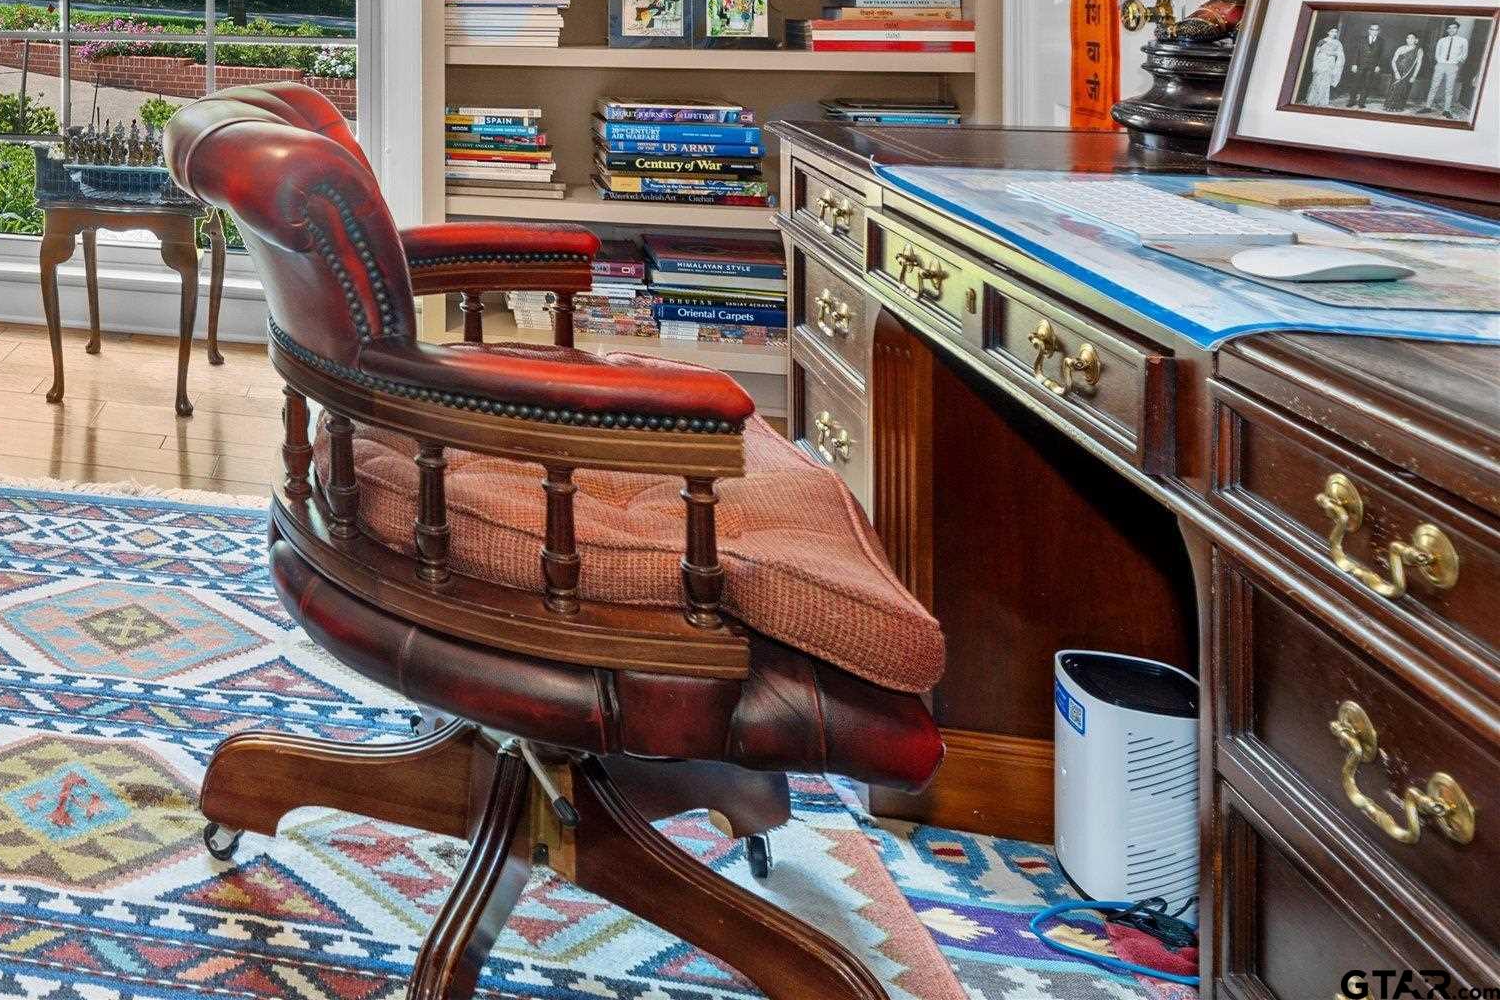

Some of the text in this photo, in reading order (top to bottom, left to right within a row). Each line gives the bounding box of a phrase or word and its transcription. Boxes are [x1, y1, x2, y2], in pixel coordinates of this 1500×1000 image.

[638, 111, 673, 119] JOURNEYS
[684, 112, 717, 120] LIFETIME
[486, 117, 512, 125] SPAIN
[663, 143, 716, 153] US ARMY
[635, 157, 683, 172] Century
[684, 160, 696, 171] of
[696, 160, 723, 171] War
[677, 262, 723, 271] HIMALAYAN
[726, 263, 751, 272] STYLE
[677, 308, 754, 322] Oriental Carpets
